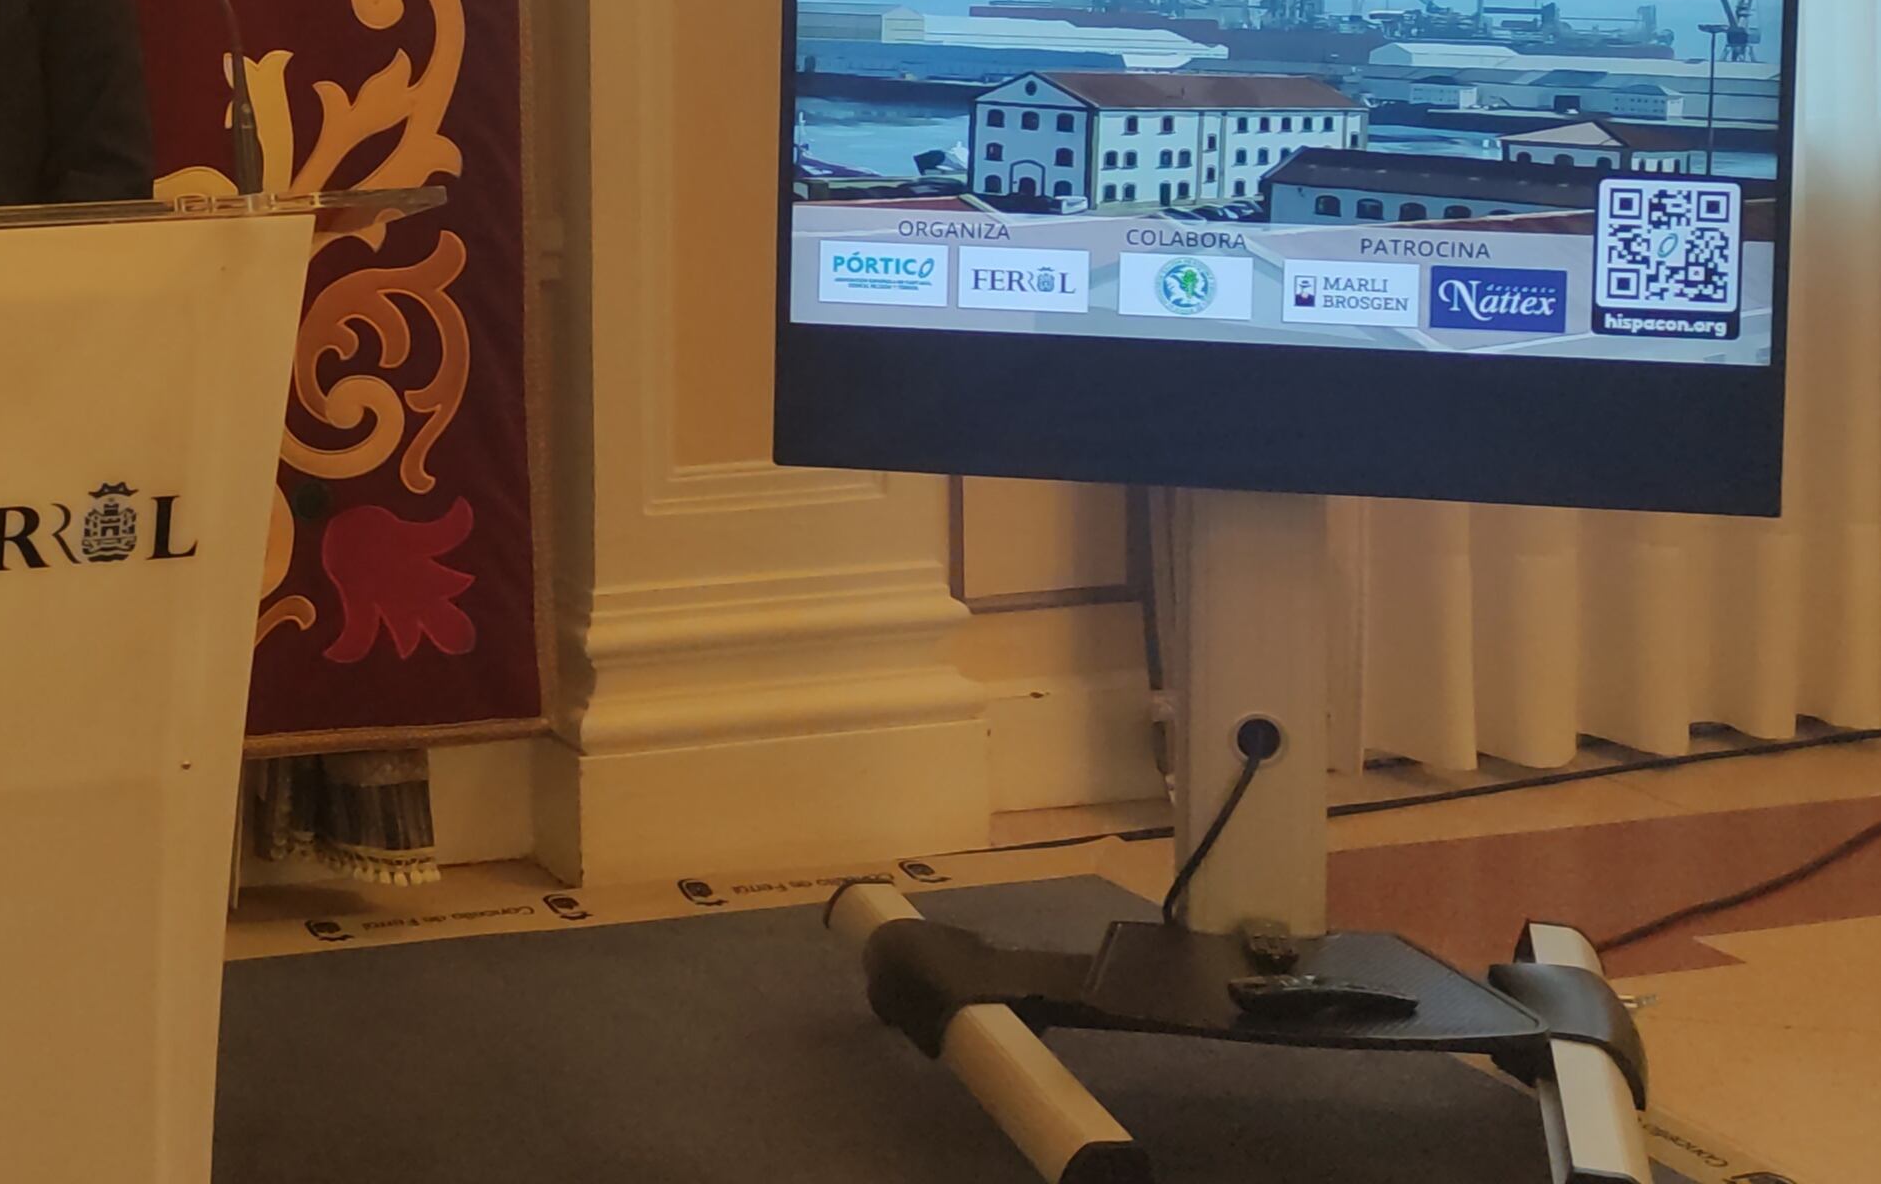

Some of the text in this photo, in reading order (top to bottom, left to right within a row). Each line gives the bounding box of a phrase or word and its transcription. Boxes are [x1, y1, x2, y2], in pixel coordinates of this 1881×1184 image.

[898, 220, 1011, 240] ORGANIZA
[1125, 228, 1248, 250] COLABORA
[1360, 238, 1491, 259] PATROCINA
[1322, 276, 1389, 294] MARLI
[1322, 292, 1409, 311] BROSGEN
[1437, 279, 1557, 322] Nattex
[1604, 313, 1727, 337] hispacon.org
